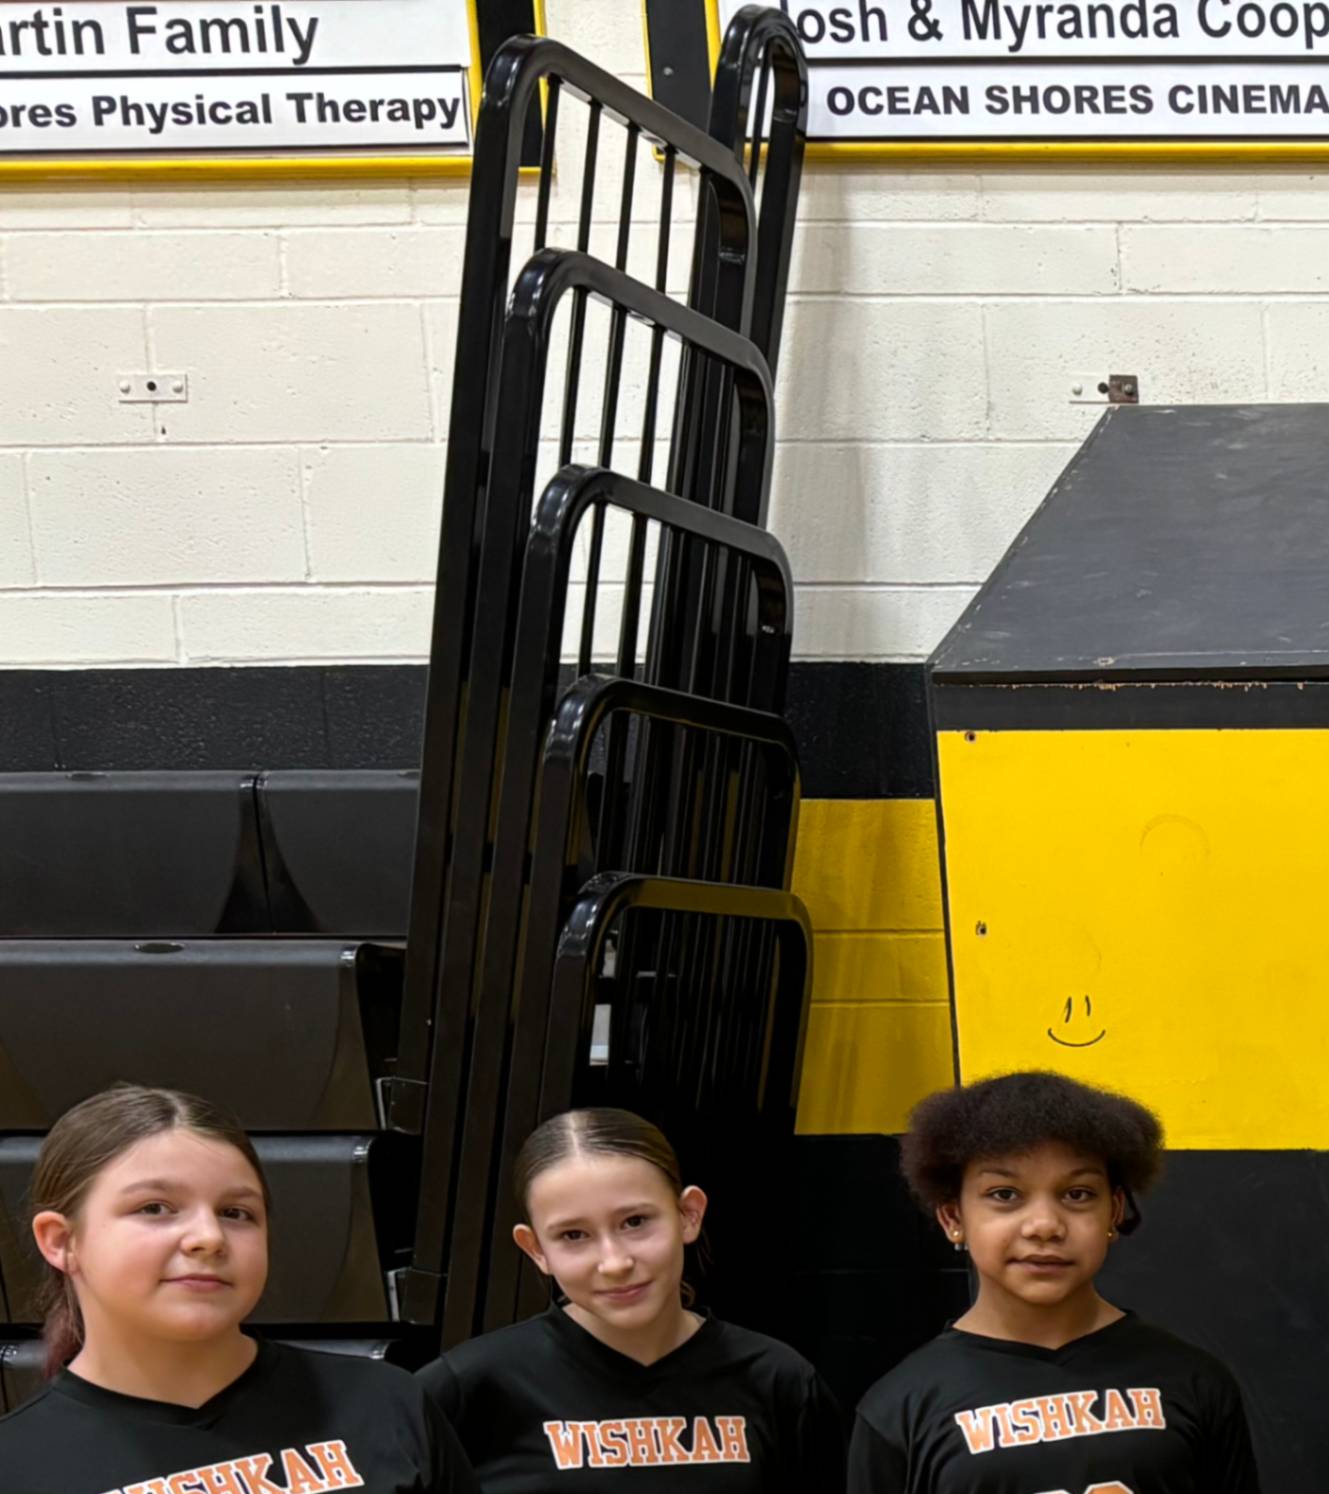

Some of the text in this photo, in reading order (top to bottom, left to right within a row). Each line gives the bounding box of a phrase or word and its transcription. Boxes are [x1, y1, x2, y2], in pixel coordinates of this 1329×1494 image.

[0, 5, 319, 66] rtin Family
[779, 0, 888, 44] osh
[907, 0, 943, 41] &
[961, 0, 1179, 53] Myranda
[92, 93, 273, 135] Physical
[286, 91, 461, 130] Therapy
[827, 86, 970, 116] OCEAN
[985, 85, 1154, 115] SHORES
[543, 1416, 751, 1470] WISHKAH
[954, 1388, 1166, 1454] WISHKAH
